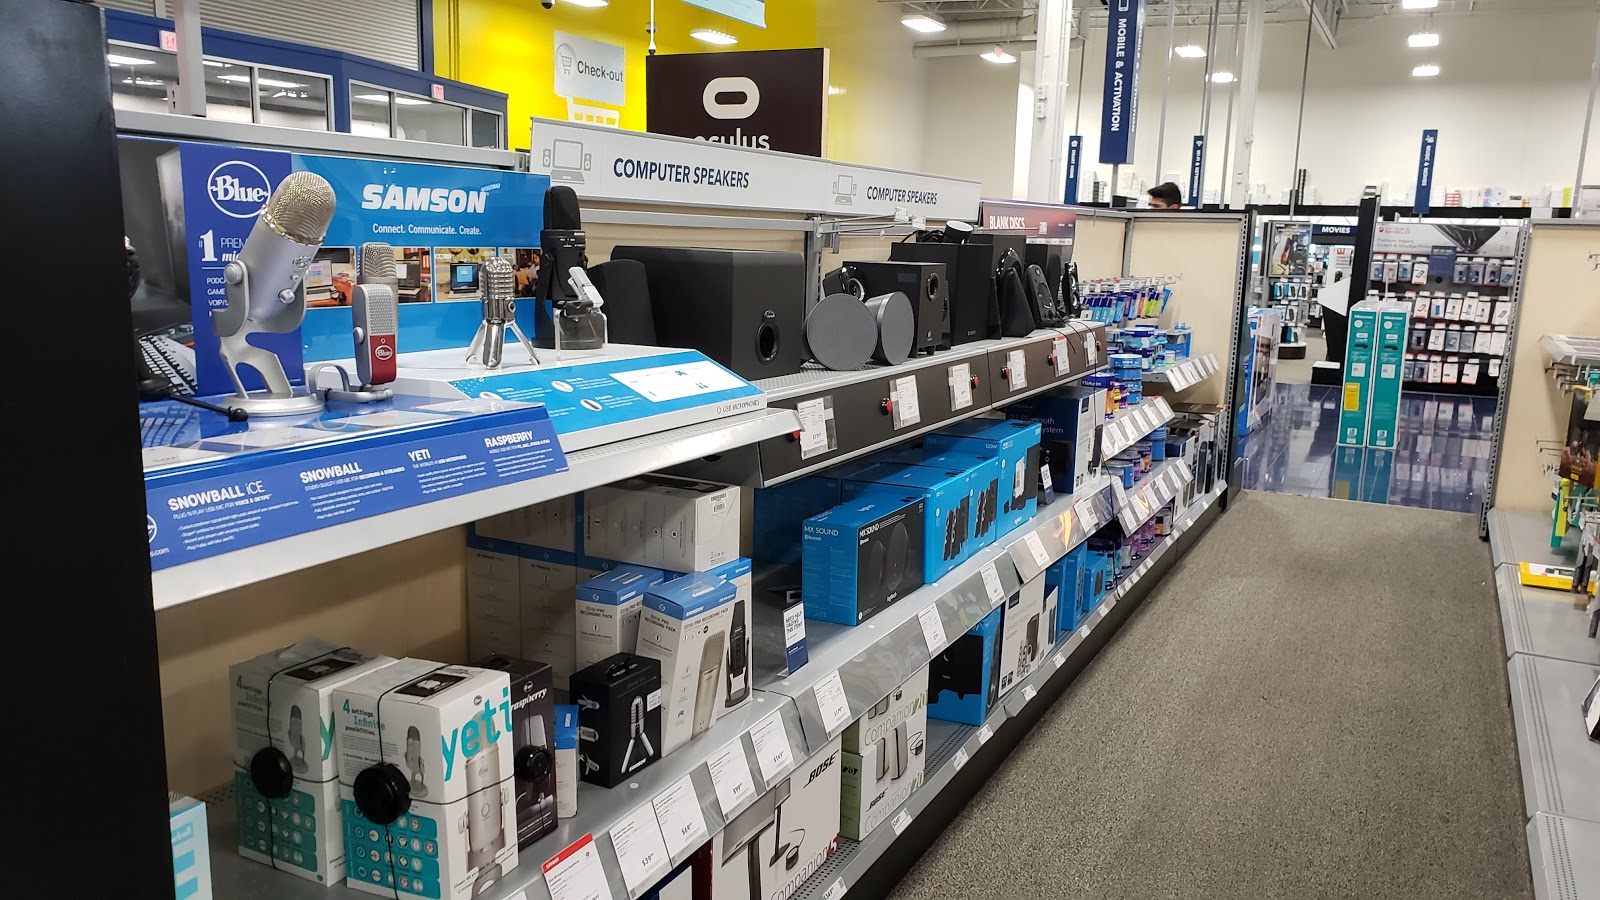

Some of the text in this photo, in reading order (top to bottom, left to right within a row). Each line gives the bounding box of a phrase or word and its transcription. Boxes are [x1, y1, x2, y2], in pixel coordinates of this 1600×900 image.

[577, 60, 624, 83] Check-out
[1110, 18, 1127, 132] MOBILE & ACTIVATION
[694, 127, 771, 151] ulus
[613, 157, 750, 190] COMPUTER SPEAKERS
[210, 175, 269, 202] Blue
[361, 183, 488, 213] SAMSON
[866, 185, 938, 206] COMPUTER SPEAKERS
[372, 223, 482, 235] Connect. Communicate. Create.
[989, 215, 1026, 230] BLANK DISCS
[1321, 226, 1351, 234] MOVIES
[722, 398, 760, 413] USB MICROPHONES
[484, 430, 533, 449] RASPBERRY
[407, 448, 431, 463] YETI
[299, 461, 363, 484] SNOWBALL
[167, 479, 267, 512] SNOWBALL iCE
[804, 525, 839, 537] MX SOUND
[860, 523, 880, 539] MX SOUND
[343, 698, 374, 718] 4 settings.
[511, 687, 548, 712] raspberry
[441, 686, 512, 782] yeti
[864, 701, 913, 746] Companion
[805, 751, 838, 786] BOSE
[867, 788, 888, 811] BOSE
[864, 789, 912, 834] Companion
